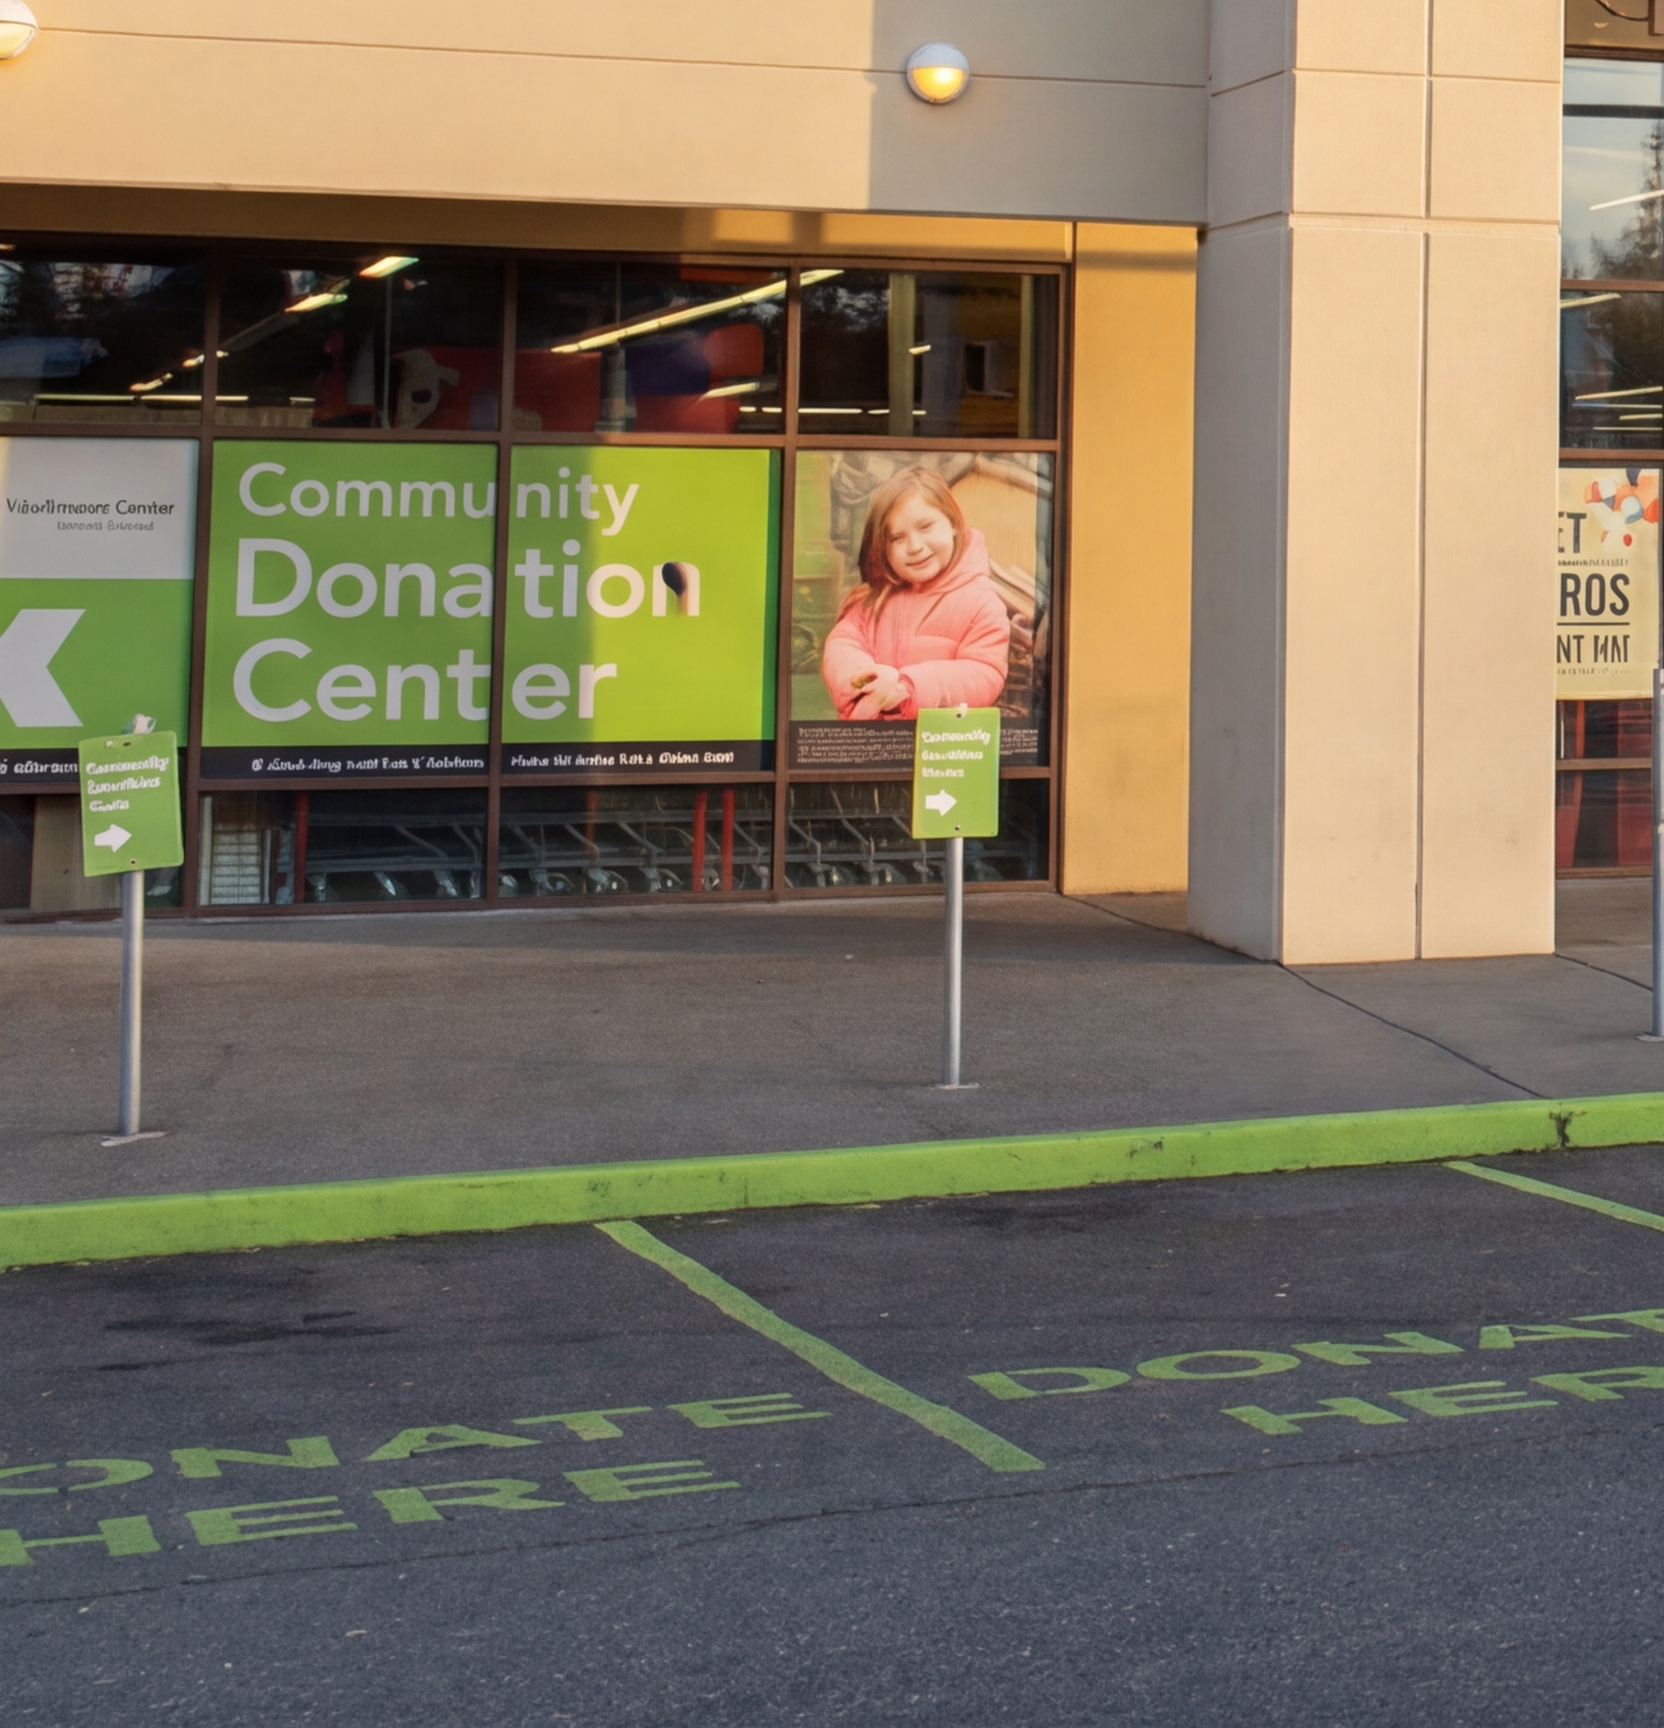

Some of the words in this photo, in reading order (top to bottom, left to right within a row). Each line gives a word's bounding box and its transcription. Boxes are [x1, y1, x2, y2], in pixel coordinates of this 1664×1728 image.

[238, 461, 640, 537] Community
[235, 537, 701, 619] Donation
[232, 637, 618, 724] Center
[0, 1460, 741, 1566] HERE
